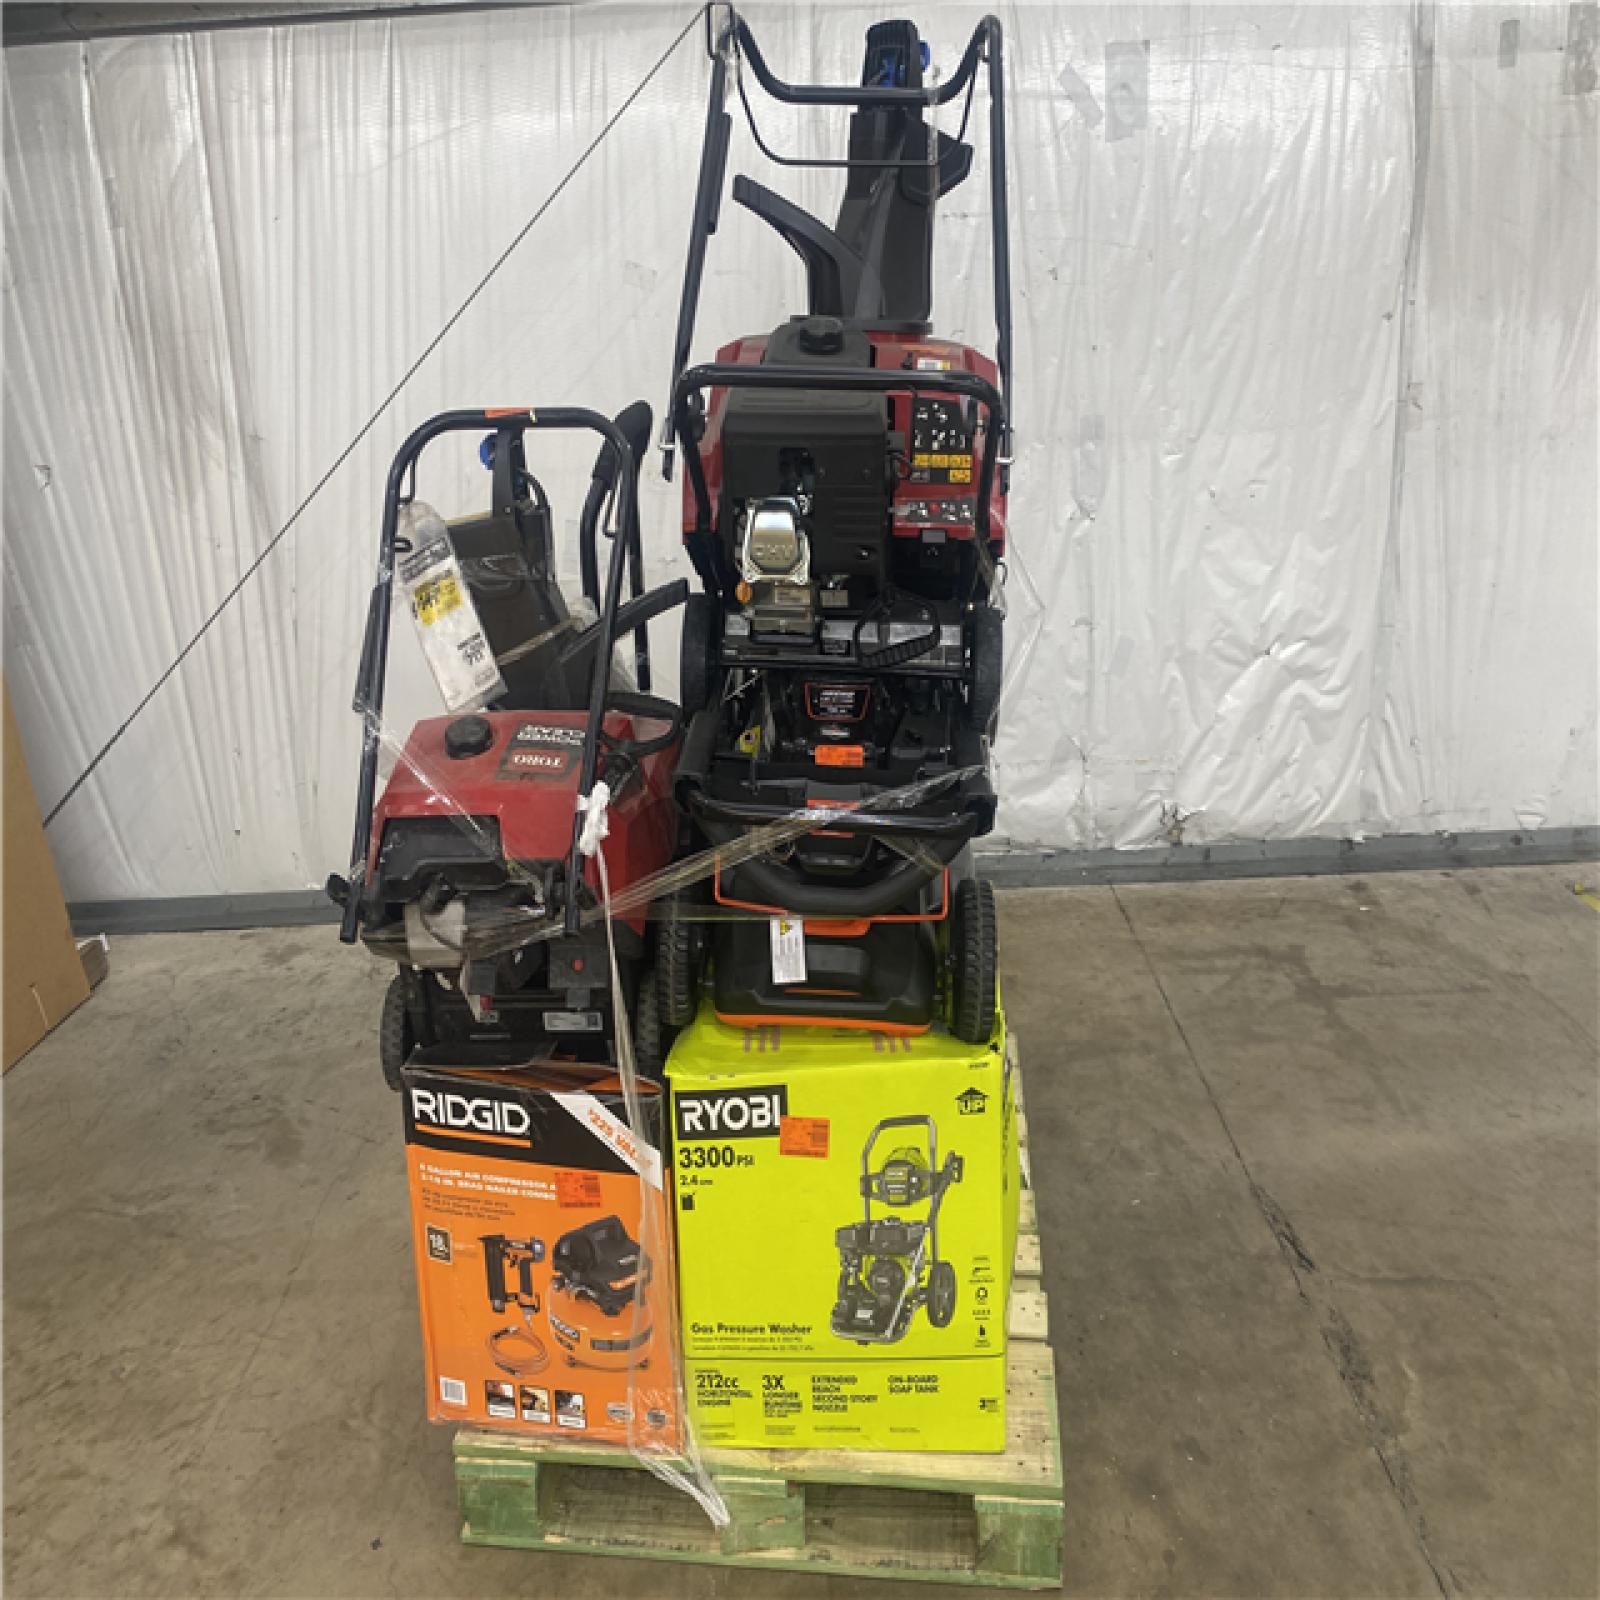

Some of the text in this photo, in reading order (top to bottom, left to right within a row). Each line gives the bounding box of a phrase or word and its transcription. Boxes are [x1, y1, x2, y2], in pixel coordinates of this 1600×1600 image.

[411, 1088, 531, 1136] RIDGID
[679, 1095, 781, 1132] RYOBI
[960, 1098, 984, 1114] UP
[679, 1146, 735, 1169] 3300
[690, 1322, 813, 1334] Gas Pressure Washer
[695, 1374, 739, 1389] 212cc
[762, 1374, 785, 1391] 3X
